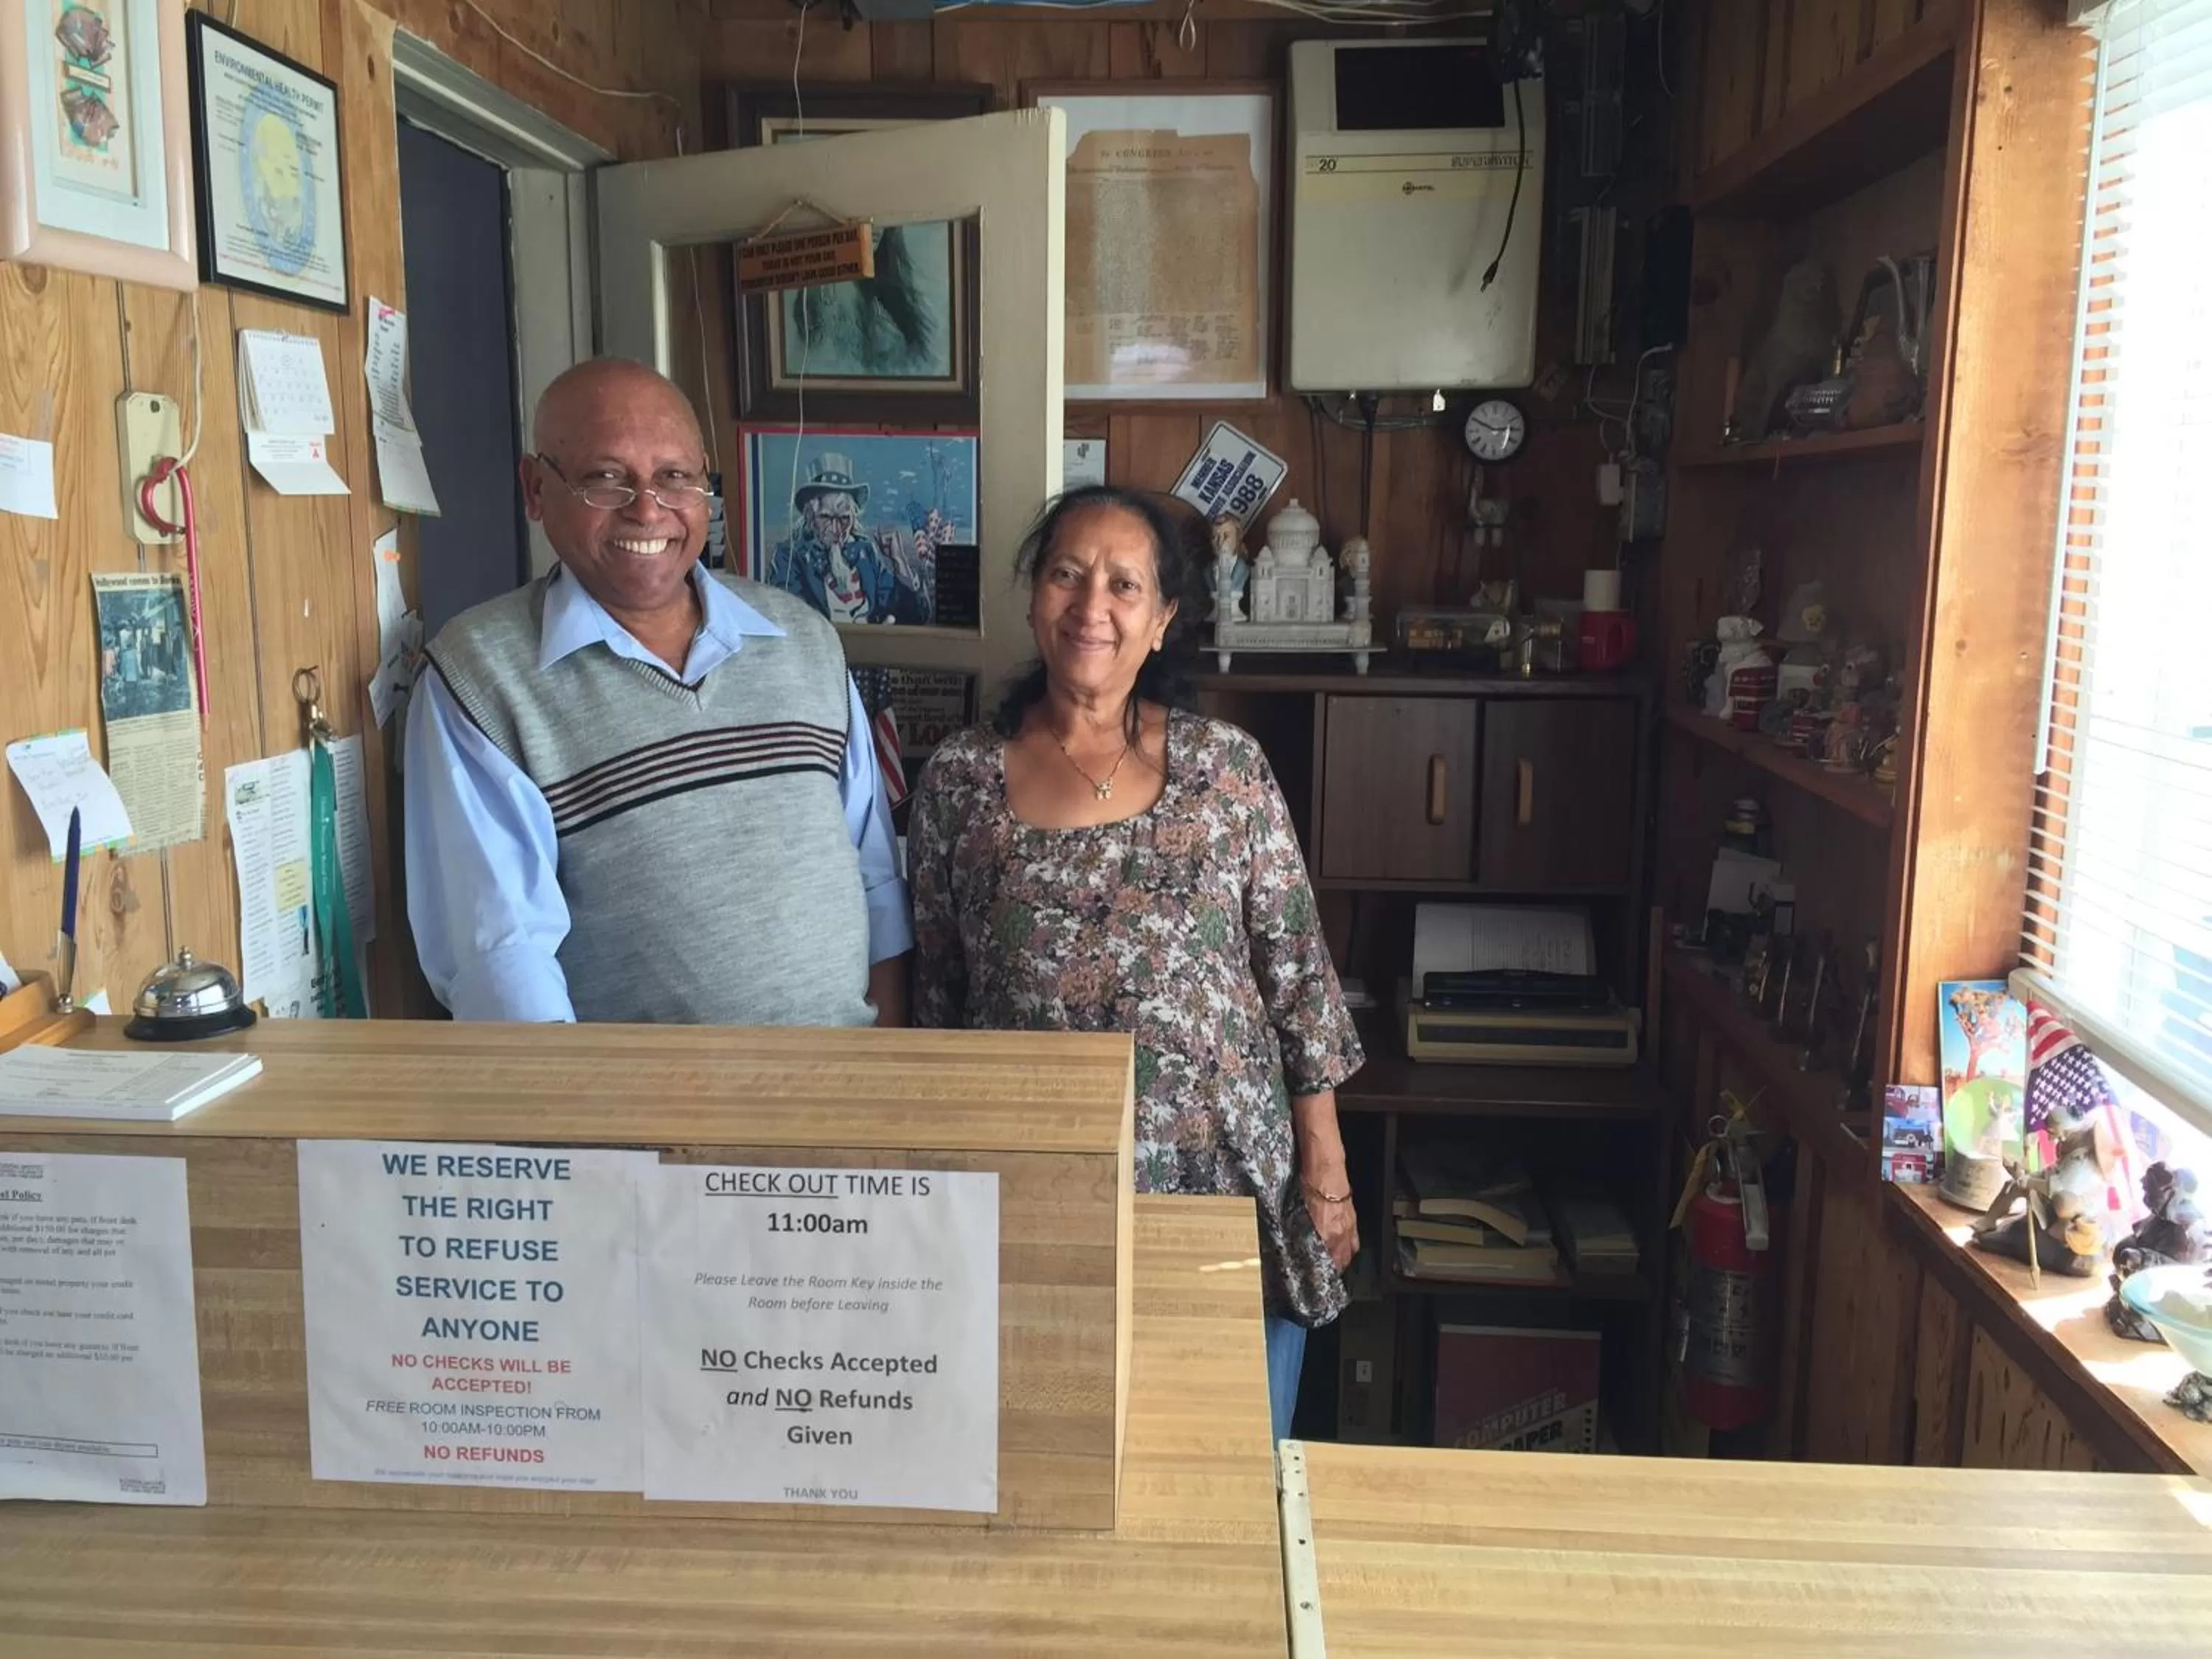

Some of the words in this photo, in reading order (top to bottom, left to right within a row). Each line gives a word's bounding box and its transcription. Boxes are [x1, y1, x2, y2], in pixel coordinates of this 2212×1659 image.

[215, 49, 274, 89] ENVIRONMENTAL
[274, 80, 301, 100] HEALTH
[302, 93, 324, 112] PERMIT
[1318, 158, 1337, 173] 20
[1197, 458, 1235, 505] KANSAS
[381, 1153, 428, 1177] WE
[437, 1155, 571, 1180] RESERVE
[12, 1189, 42, 1202] Policy
[705, 1172, 784, 1198] CHECK
[785, 1173, 839, 1200] OUT
[844, 1175, 903, 1196] TIME
[911, 1176, 931, 1197] IS
[401, 1194, 458, 1218] THE
[467, 1197, 554, 1221] RIGHT
[768, 1212, 868, 1234] 11:00am
[398, 1235, 437, 1258] TO
[445, 1237, 559, 1262] REFUSE
[396, 1275, 518, 1301] SERVICE
[525, 1280, 564, 1303] TO
[694, 1272, 738, 1286] Please
[740, 1273, 779, 1288] Leave
[782, 1275, 805, 1288] the
[807, 1275, 848, 1290] Room
[850, 1276, 875, 1293] Key
[877, 1276, 918, 1292] inside
[920, 1278, 943, 1291] the
[748, 1295, 787, 1310] Room
[790, 1297, 835, 1313] before
[837, 1298, 890, 1314] Leaving
[421, 1317, 539, 1343] ANYONE
[392, 1354, 418, 1368] NO
[422, 1354, 495, 1372] CHECKS
[499, 1358, 543, 1374] WILL
[546, 1360, 571, 1374] BE
[700, 1348, 738, 1373] NO
[743, 1349, 824, 1371] Checks
[830, 1352, 938, 1377] Accepted
[431, 1376, 532, 1395] ACCEPTED!
[365, 1399, 407, 1414] FREE
[408, 1402, 456, 1416] ROOM
[460, 1403, 552, 1420] INSPECTION
[554, 1405, 601, 1421] FROM
[726, 1387, 770, 1407] and
[774, 1388, 813, 1413] NO
[819, 1388, 914, 1411] Refunds
[421, 1420, 546, 1438] 10:00AM-10:00PM
[787, 1425, 852, 1445] Given
[1500, 1420, 1563, 1452] APER
[424, 1444, 451, 1460] NO
[456, 1446, 545, 1464] REFUNDS
[783, 1486, 827, 1499] THANK
[830, 1488, 858, 1500] YOU
